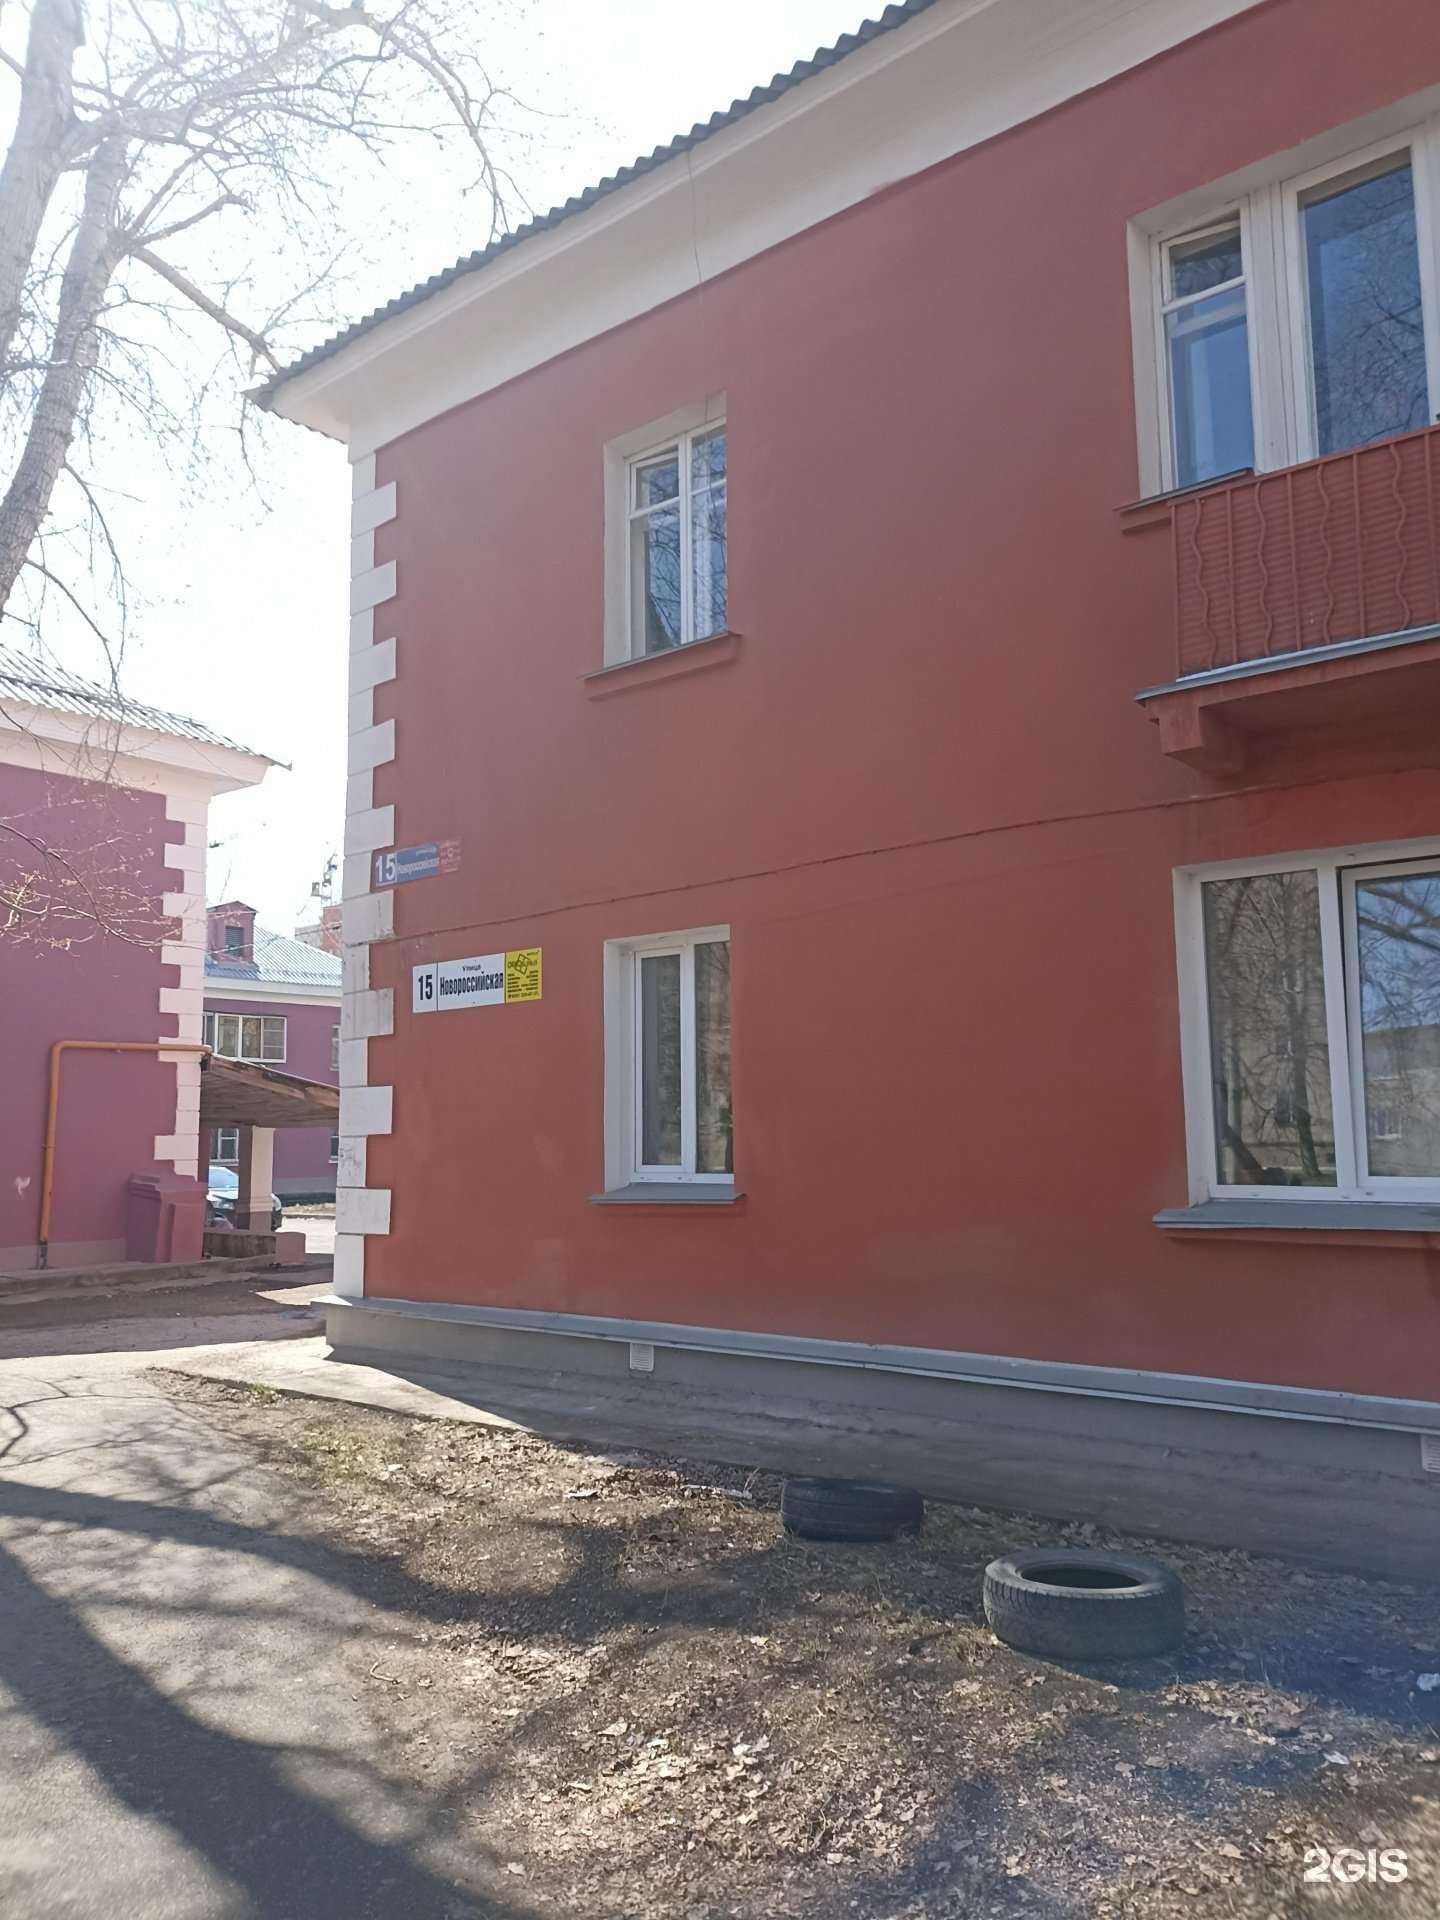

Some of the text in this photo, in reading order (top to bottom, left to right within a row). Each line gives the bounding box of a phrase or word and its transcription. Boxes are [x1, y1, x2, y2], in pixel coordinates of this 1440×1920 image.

[376, 855, 395, 882] 15
[418, 974, 433, 1000] 15
[440, 972, 504, 996] Новороссийская
